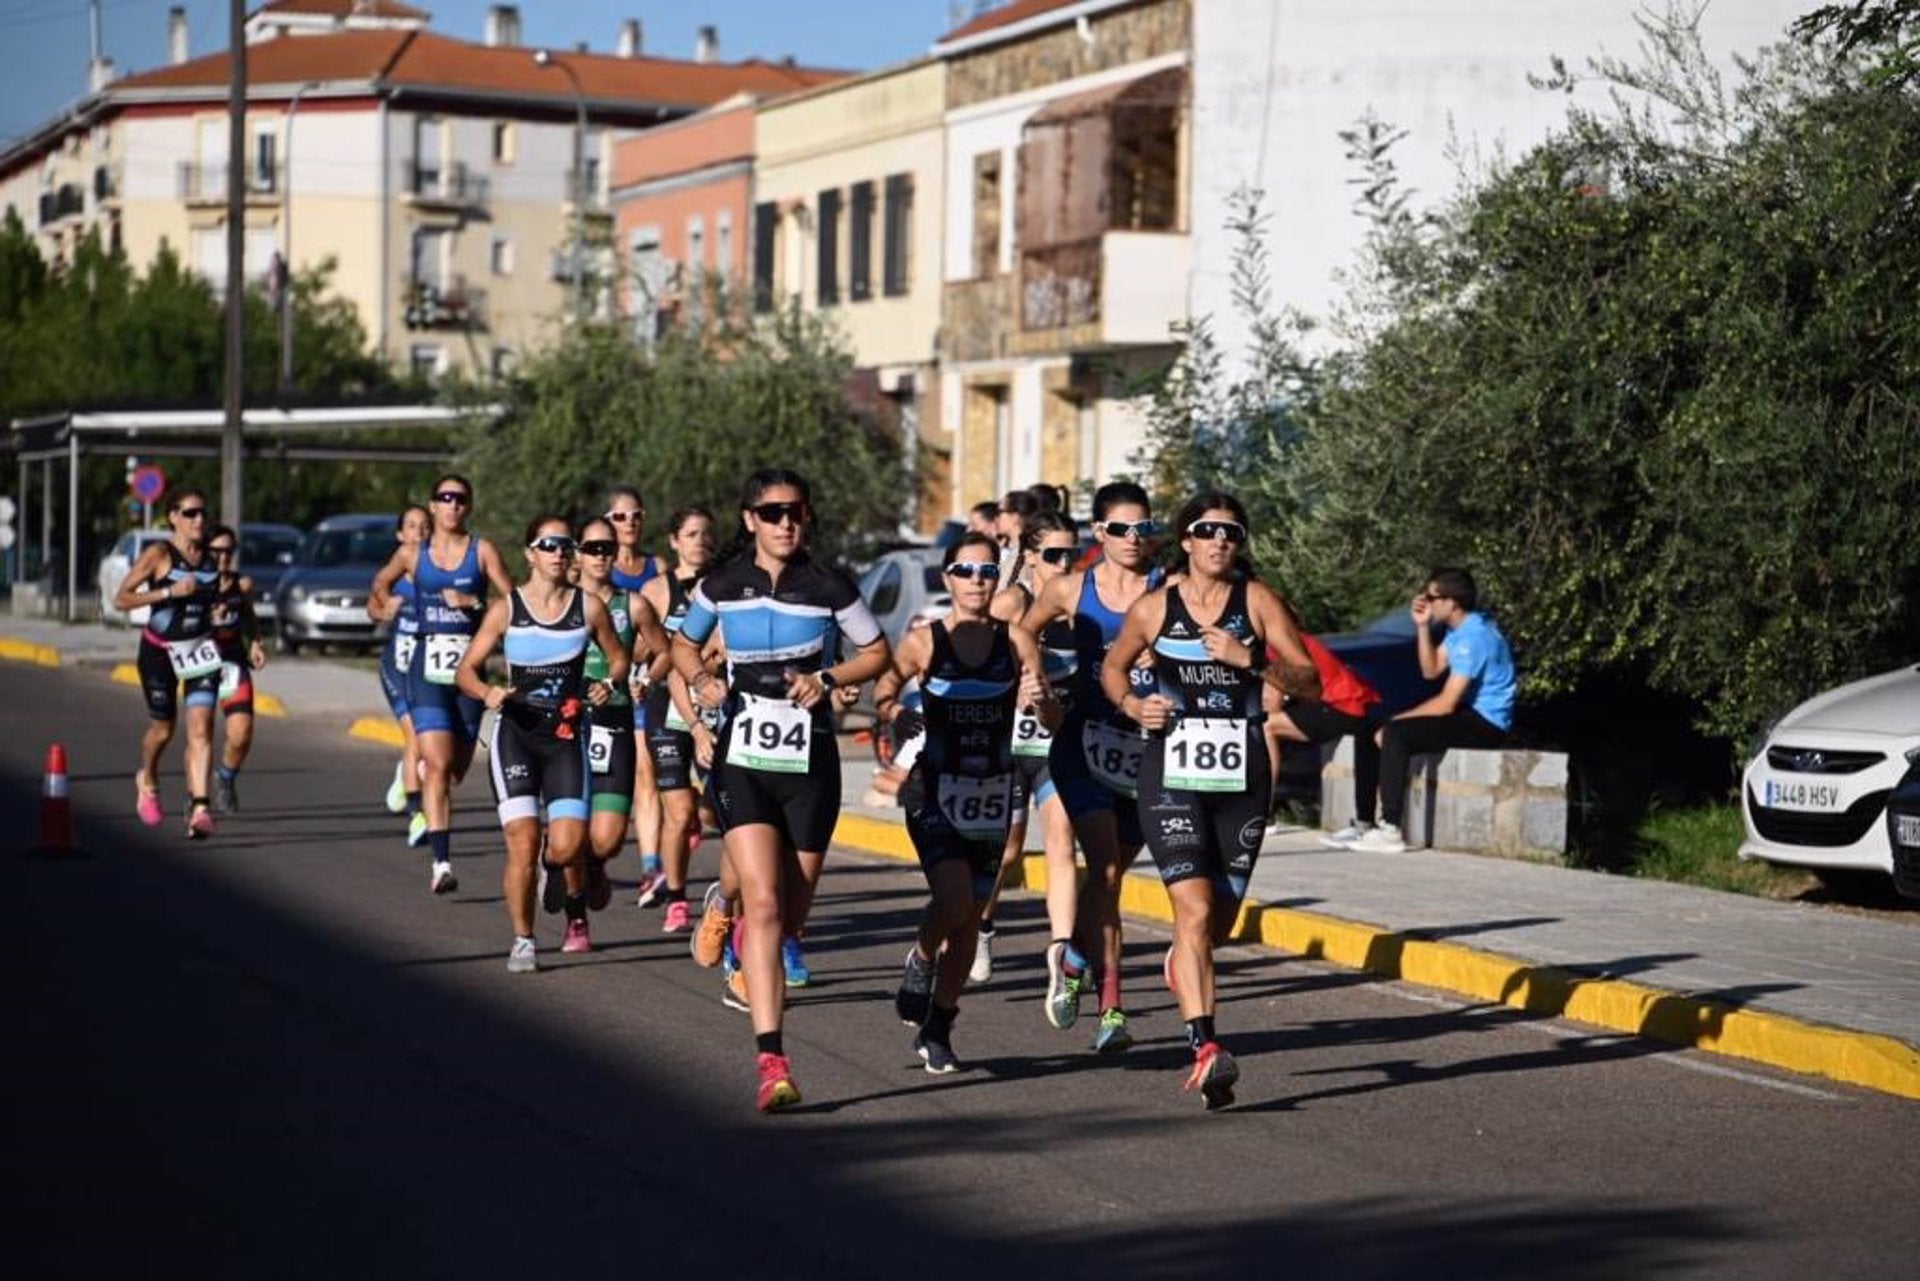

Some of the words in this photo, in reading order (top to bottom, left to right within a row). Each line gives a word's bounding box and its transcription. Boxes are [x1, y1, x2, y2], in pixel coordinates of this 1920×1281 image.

[174, 645, 216, 669] 116
[1178, 664, 1240, 686] MURIEL
[947, 703, 1003, 723] TERESA
[738, 717, 807, 751] 194
[1087, 744, 1142, 779] 183
[1171, 740, 1242, 771] 186
[943, 794, 1005, 821] 185
[1774, 784, 1806, 804] 3448
[1810, 786, 1839, 807] HSV
